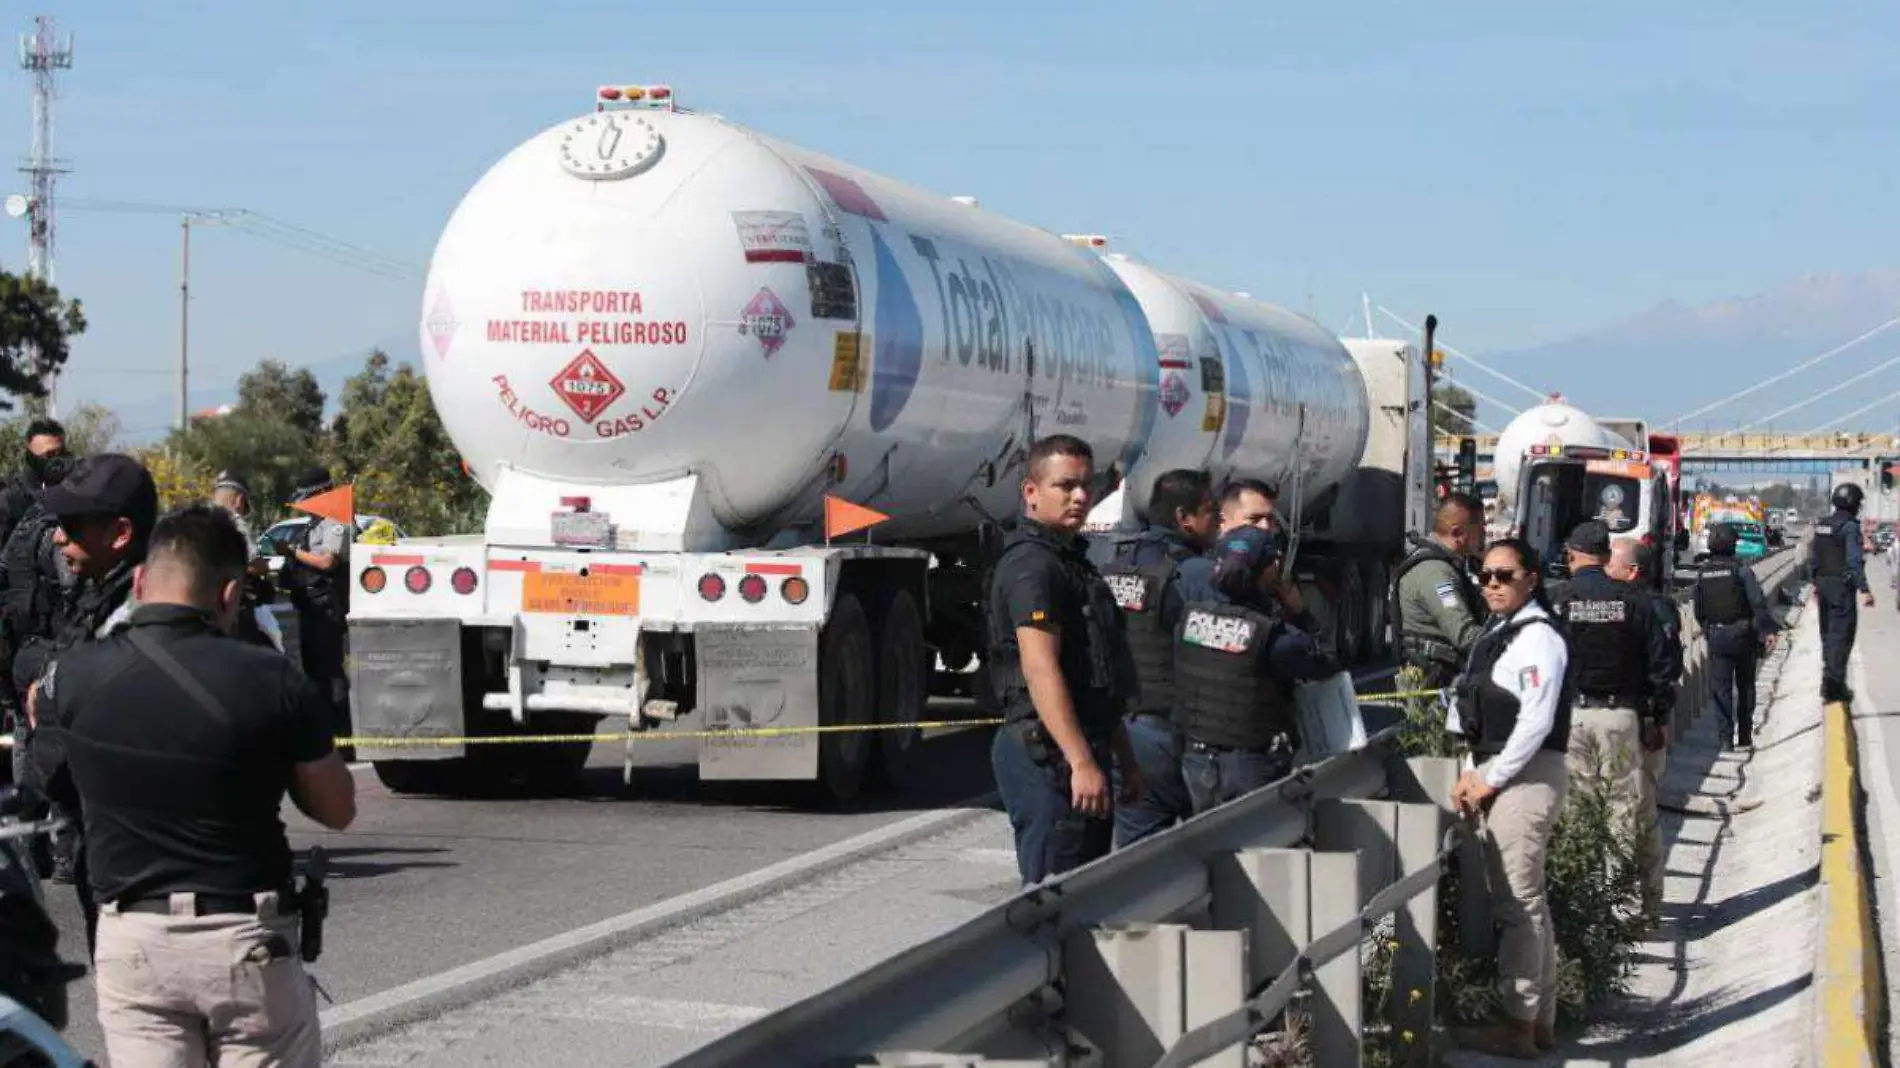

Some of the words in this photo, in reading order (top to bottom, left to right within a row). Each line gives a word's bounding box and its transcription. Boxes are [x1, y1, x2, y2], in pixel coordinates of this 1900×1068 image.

[522, 291, 642, 313] TRANSPORTA
[487, 320, 570, 344] MATERIAL
[577, 322, 687, 344] PELIGROSO
[569, 379, 606, 394] 1075
[492, 374, 570, 437] PELIGRO
[596, 413, 644, 438] GAS
